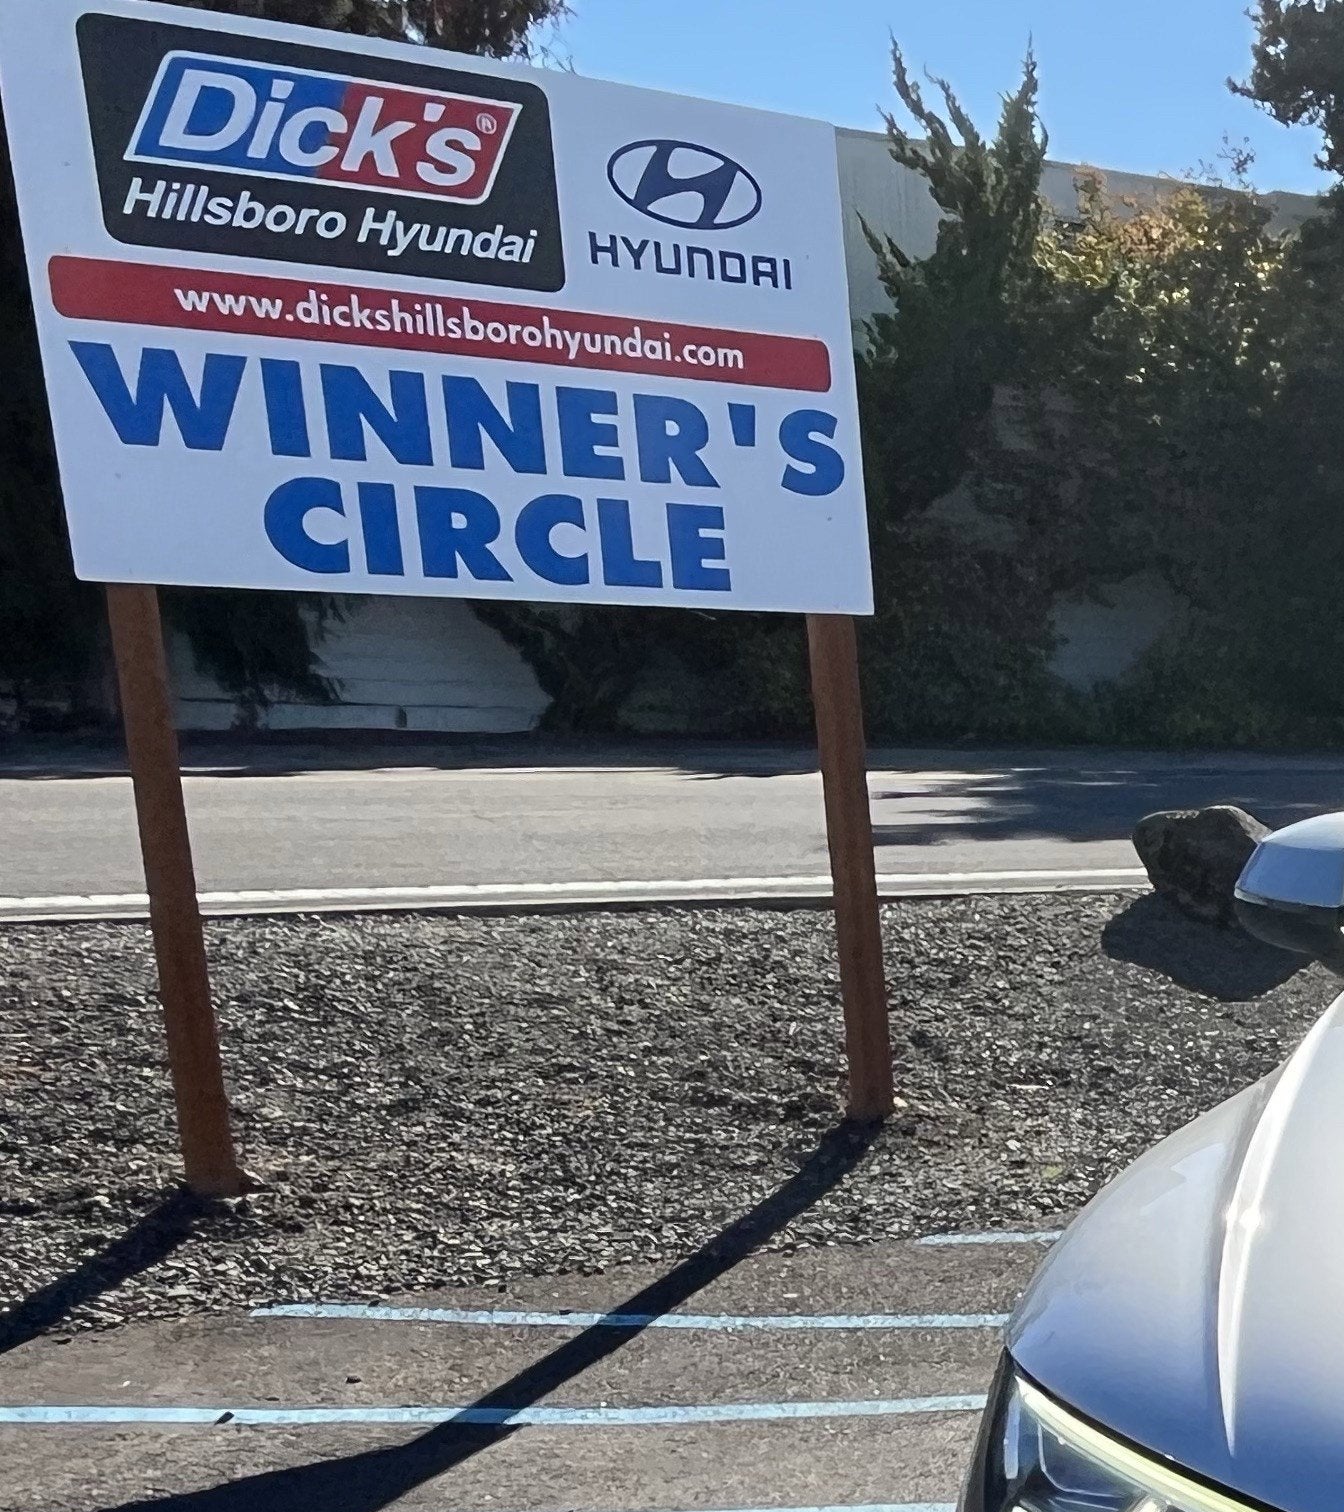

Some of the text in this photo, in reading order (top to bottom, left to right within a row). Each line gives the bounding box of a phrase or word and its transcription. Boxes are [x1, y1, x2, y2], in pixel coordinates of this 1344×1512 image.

[158, 68, 484, 186] Dick's
[123, 177, 538, 265] Hillsboro Hyundai
[589, 231, 792, 290] HYUNDAI
[174, 283, 745, 370] www.dickshillsborohyundai.com
[69, 341, 845, 497] WINNER'S
[264, 477, 732, 591] CIRCLE
